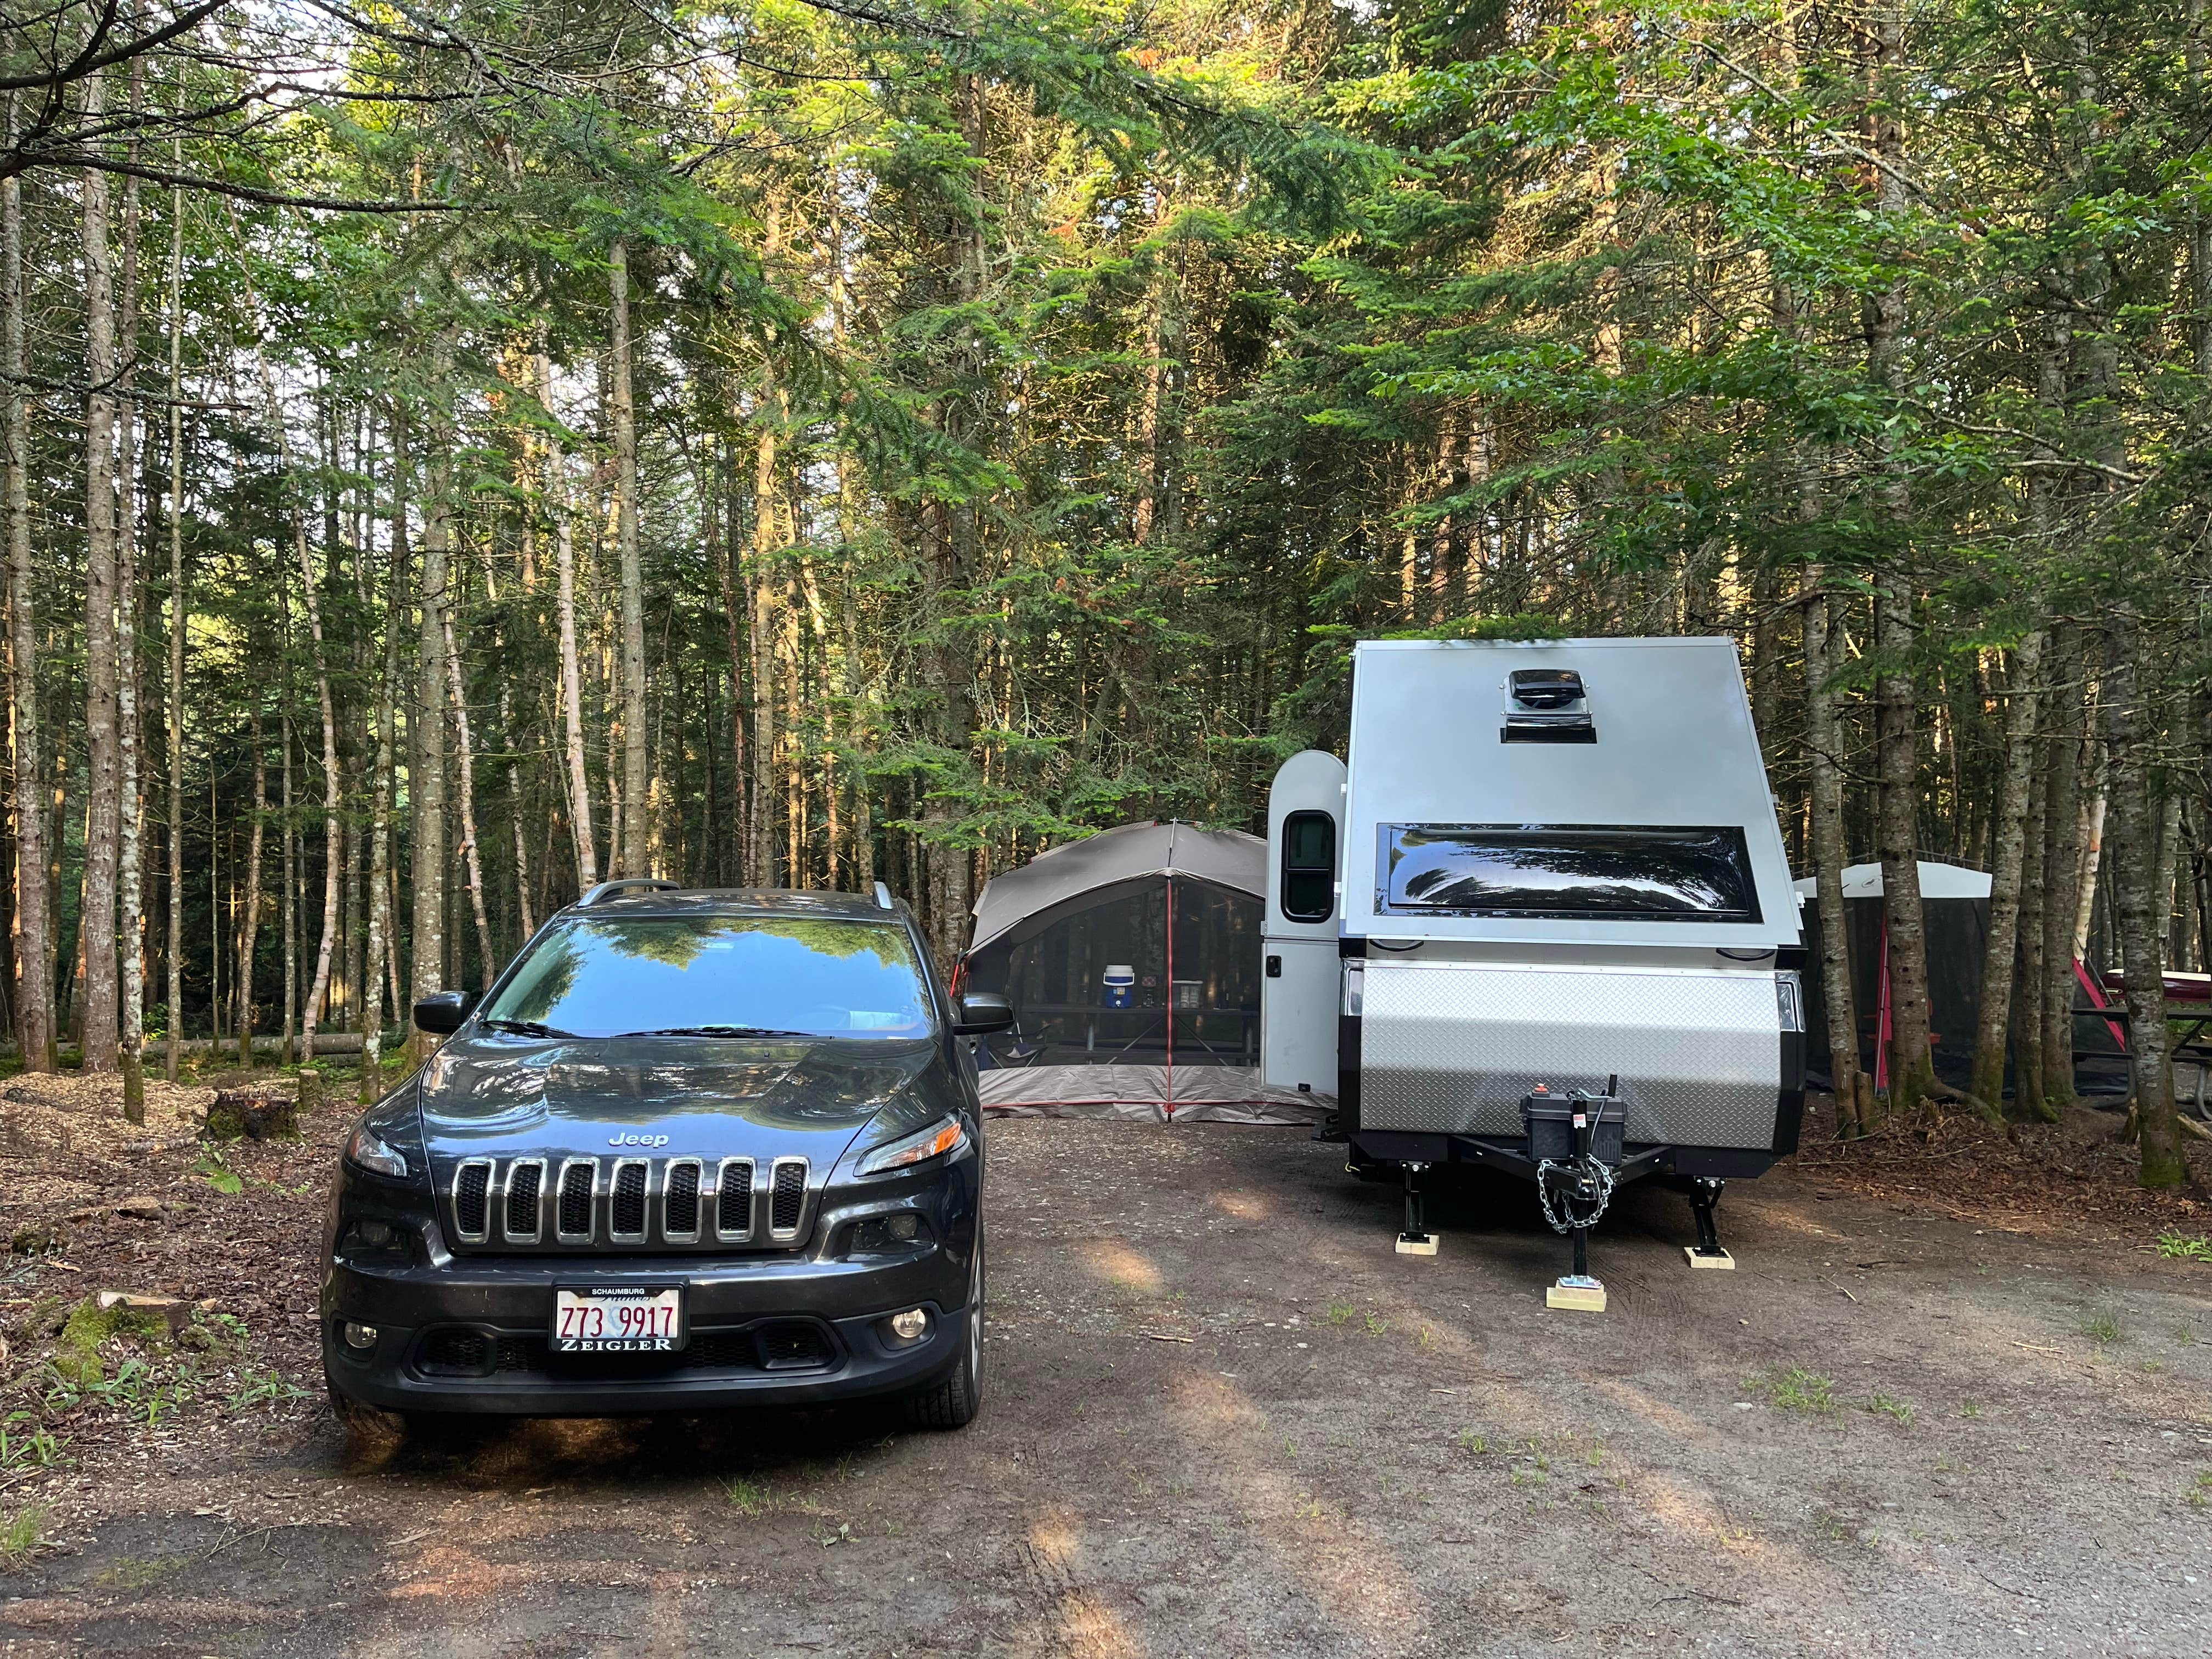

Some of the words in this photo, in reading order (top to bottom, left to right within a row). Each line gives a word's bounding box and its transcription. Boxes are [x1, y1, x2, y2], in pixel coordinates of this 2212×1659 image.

[608, 1132, 669, 1148] Jeep
[561, 1307, 603, 1338] Z73
[619, 1307, 673, 1337] 9917
[561, 1339, 672, 1351] ZEIGLER
